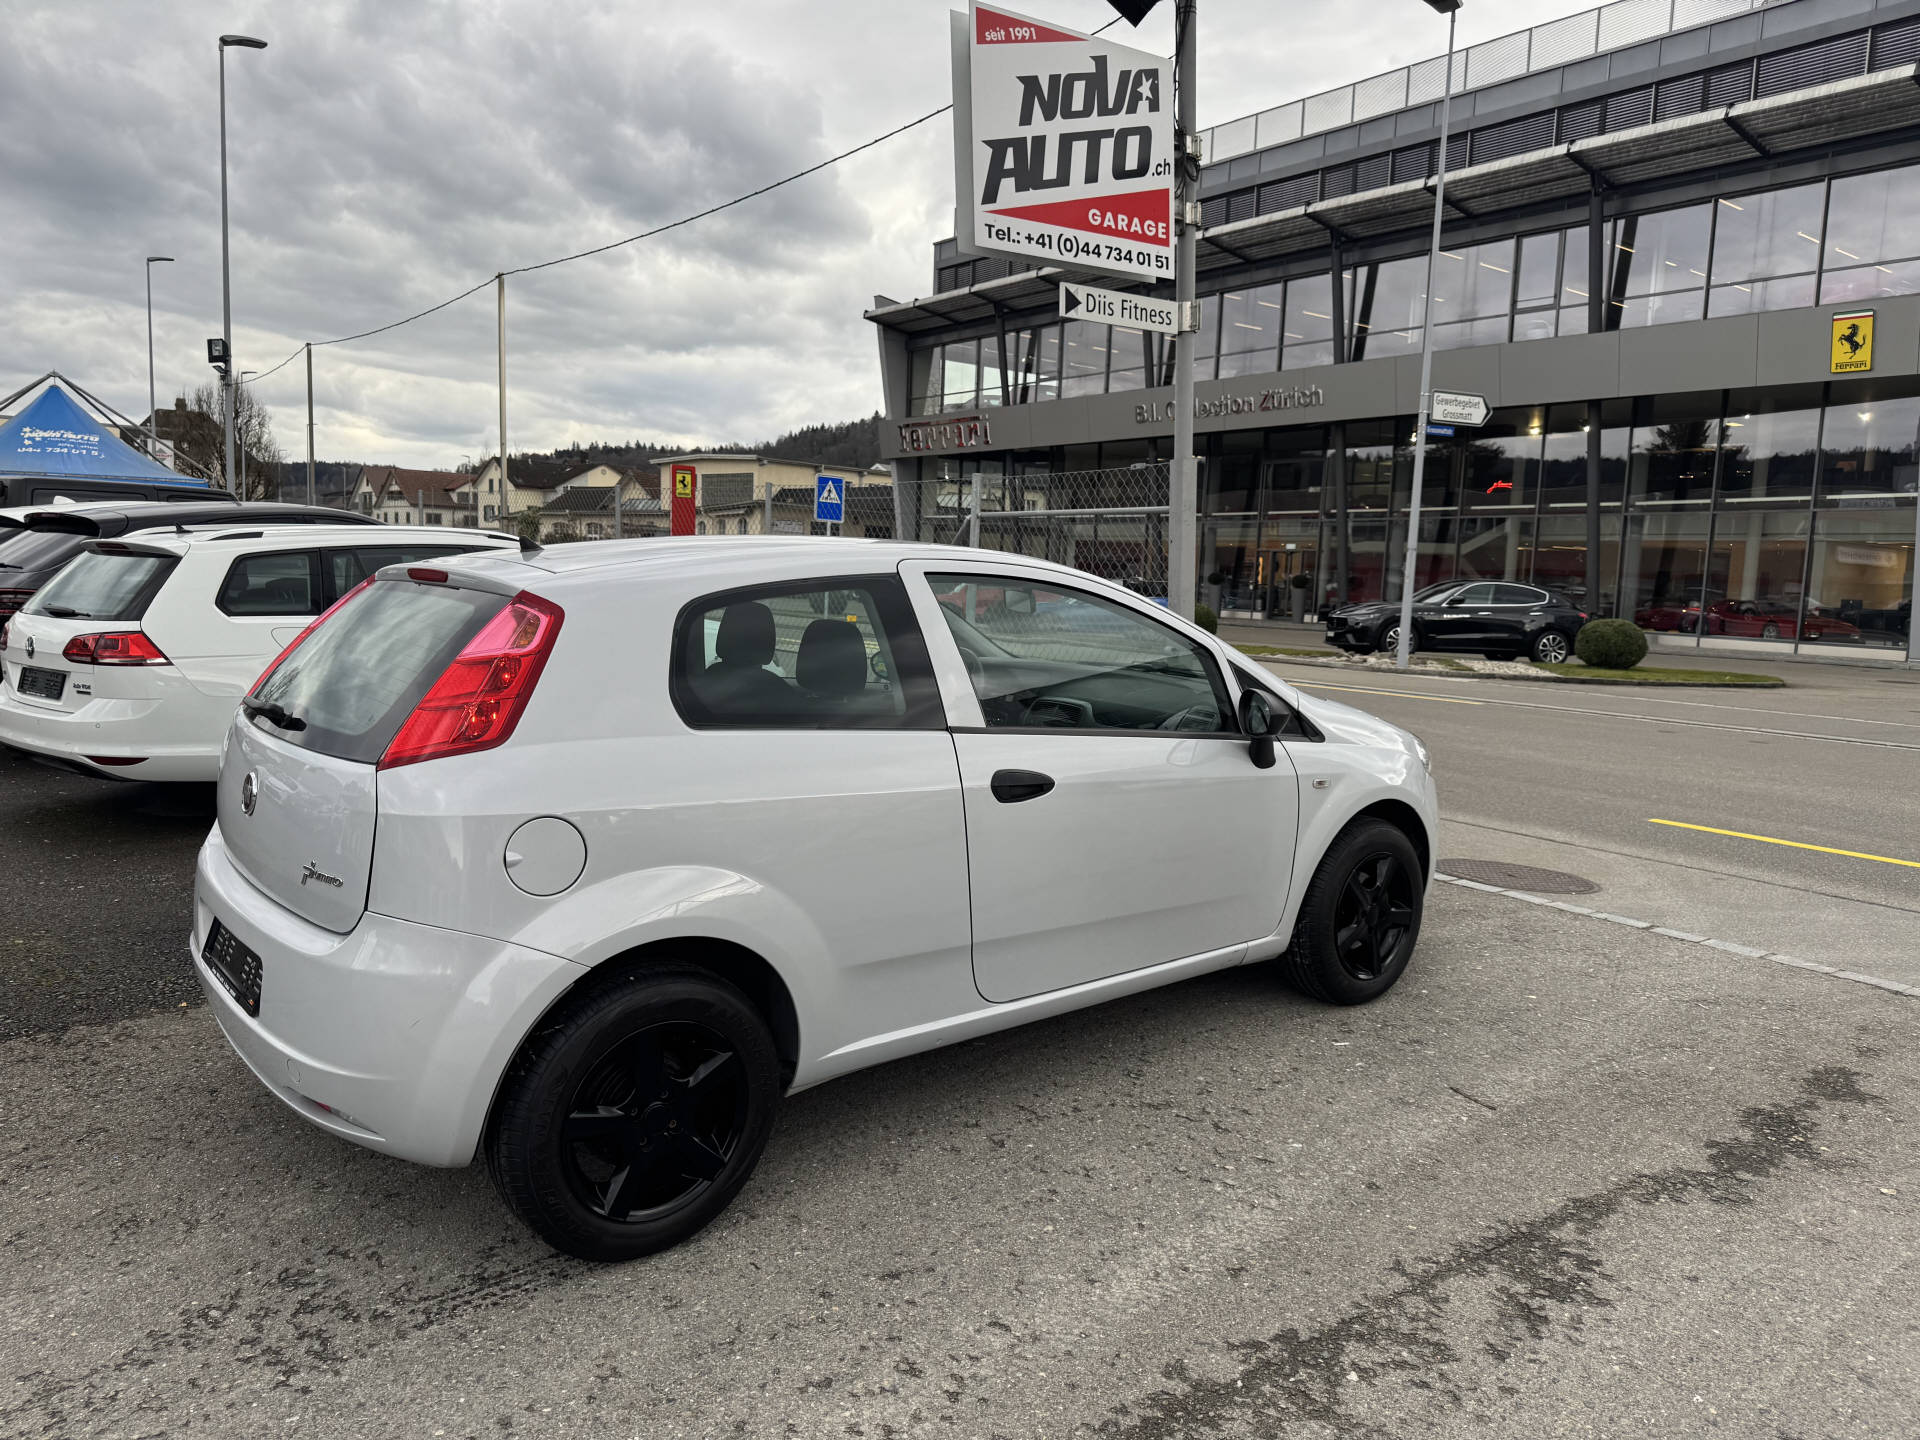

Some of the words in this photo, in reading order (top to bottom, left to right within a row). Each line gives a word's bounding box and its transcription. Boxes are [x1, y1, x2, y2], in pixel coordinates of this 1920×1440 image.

[985, 27, 1005, 41] seit
[1009, 27, 1037, 41] 1991
[1015, 55, 1160, 126] NOVA
[1088, 208, 1167, 239] GARAGE
[984, 223, 1021, 244] Tel.:
[1024, 233, 1053, 250] +41
[1105, 245, 1133, 264] 734
[1086, 292, 1114, 317] Diis
[1121, 299, 1172, 326] Fitness
[1835, 361, 1867, 370] Ferrari
[1260, 384, 1324, 412] Zürich
[1435, 395, 1481, 409] Gewerbegebiet
[898, 414, 992, 453] Ferrari
